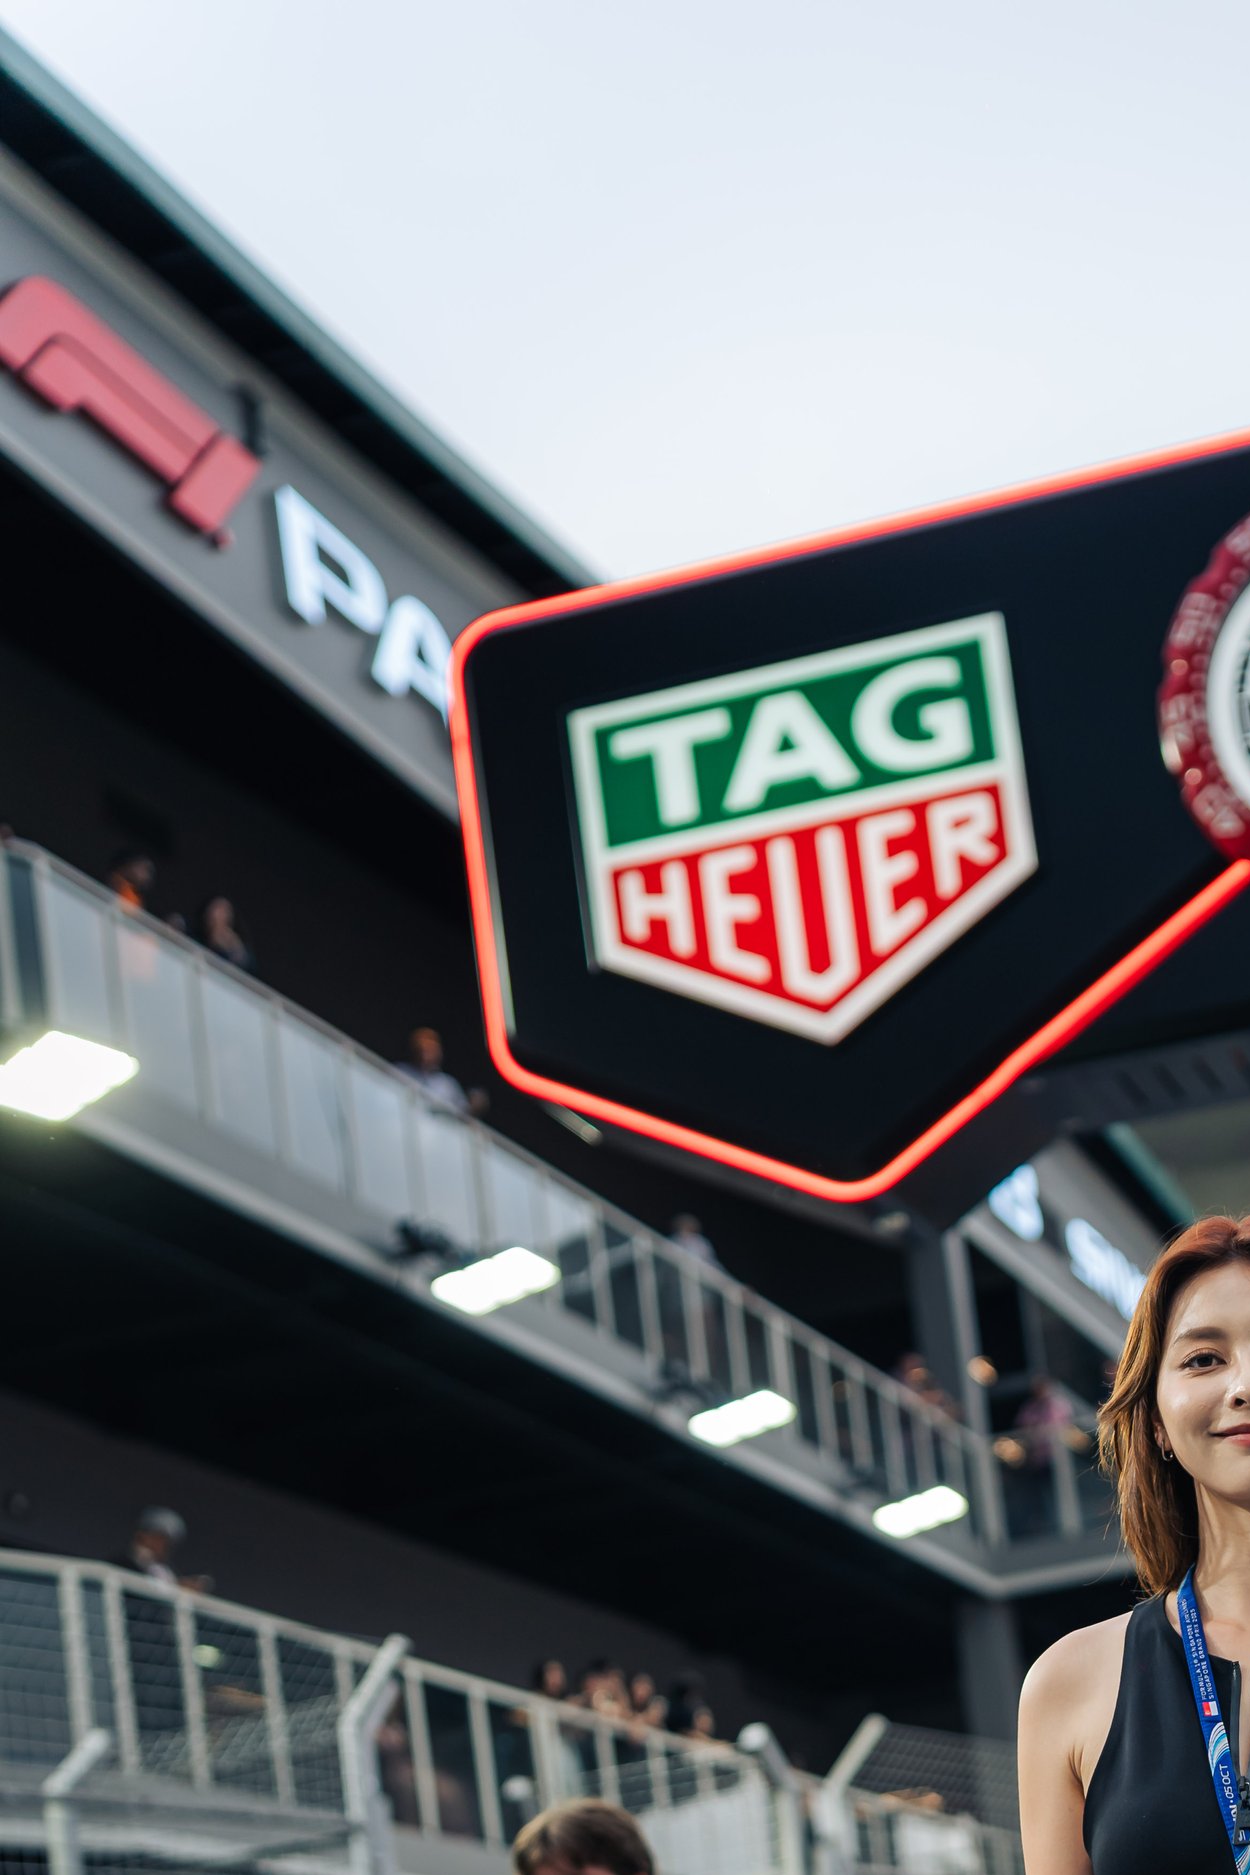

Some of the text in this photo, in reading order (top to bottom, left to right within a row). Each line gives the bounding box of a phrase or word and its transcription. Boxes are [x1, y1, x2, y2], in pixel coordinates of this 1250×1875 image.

[608, 656, 974, 827] TAG
[616, 791, 999, 1004] HEUER
[1186, 1625, 1198, 1658] SINGAPORE
[1196, 1638, 1205, 1659] GRAND
[1200, 1661, 1214, 1700] SINGAPORE
[1219, 1764, 1231, 1785] OCT
